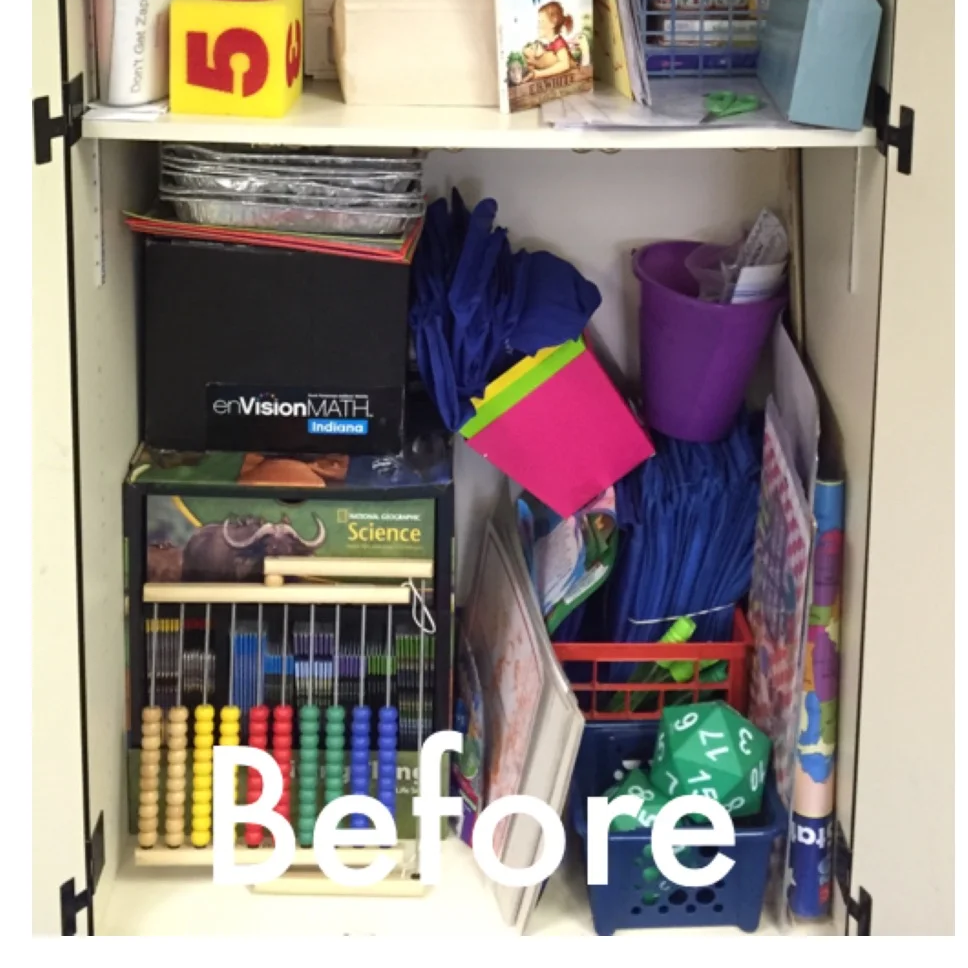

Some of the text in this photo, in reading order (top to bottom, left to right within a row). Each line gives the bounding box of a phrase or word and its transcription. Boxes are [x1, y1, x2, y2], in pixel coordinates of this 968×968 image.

[186, 26, 270, 98] 5
[312, 421, 364, 433] Indiana
[347, 521, 421, 542] Science
